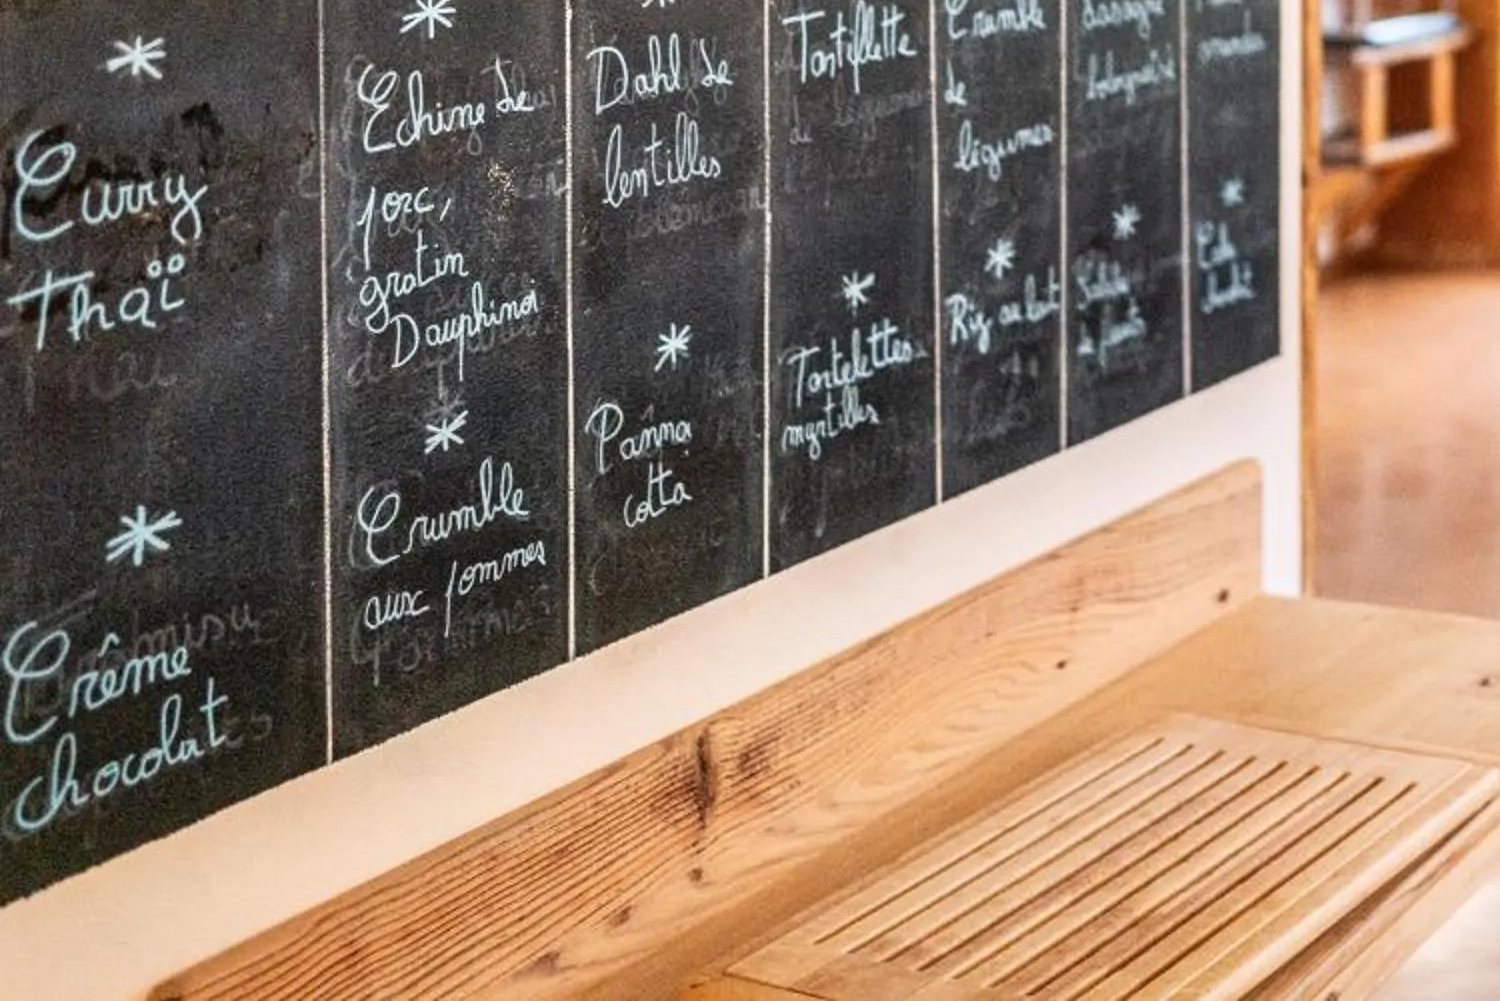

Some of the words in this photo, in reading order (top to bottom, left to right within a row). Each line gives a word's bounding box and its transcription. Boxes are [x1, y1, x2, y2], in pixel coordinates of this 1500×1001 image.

[586, 33, 681, 116] Dahl
[15, 129, 208, 244] Curry
[602, 112, 721, 208] lentilles
[7, 253, 185, 350] Thaï
[359, 229, 469, 334] gratin
[585, 403, 692, 474] Panna
[357, 456, 530, 565] Crumble
[364, 591, 430, 630] aux
